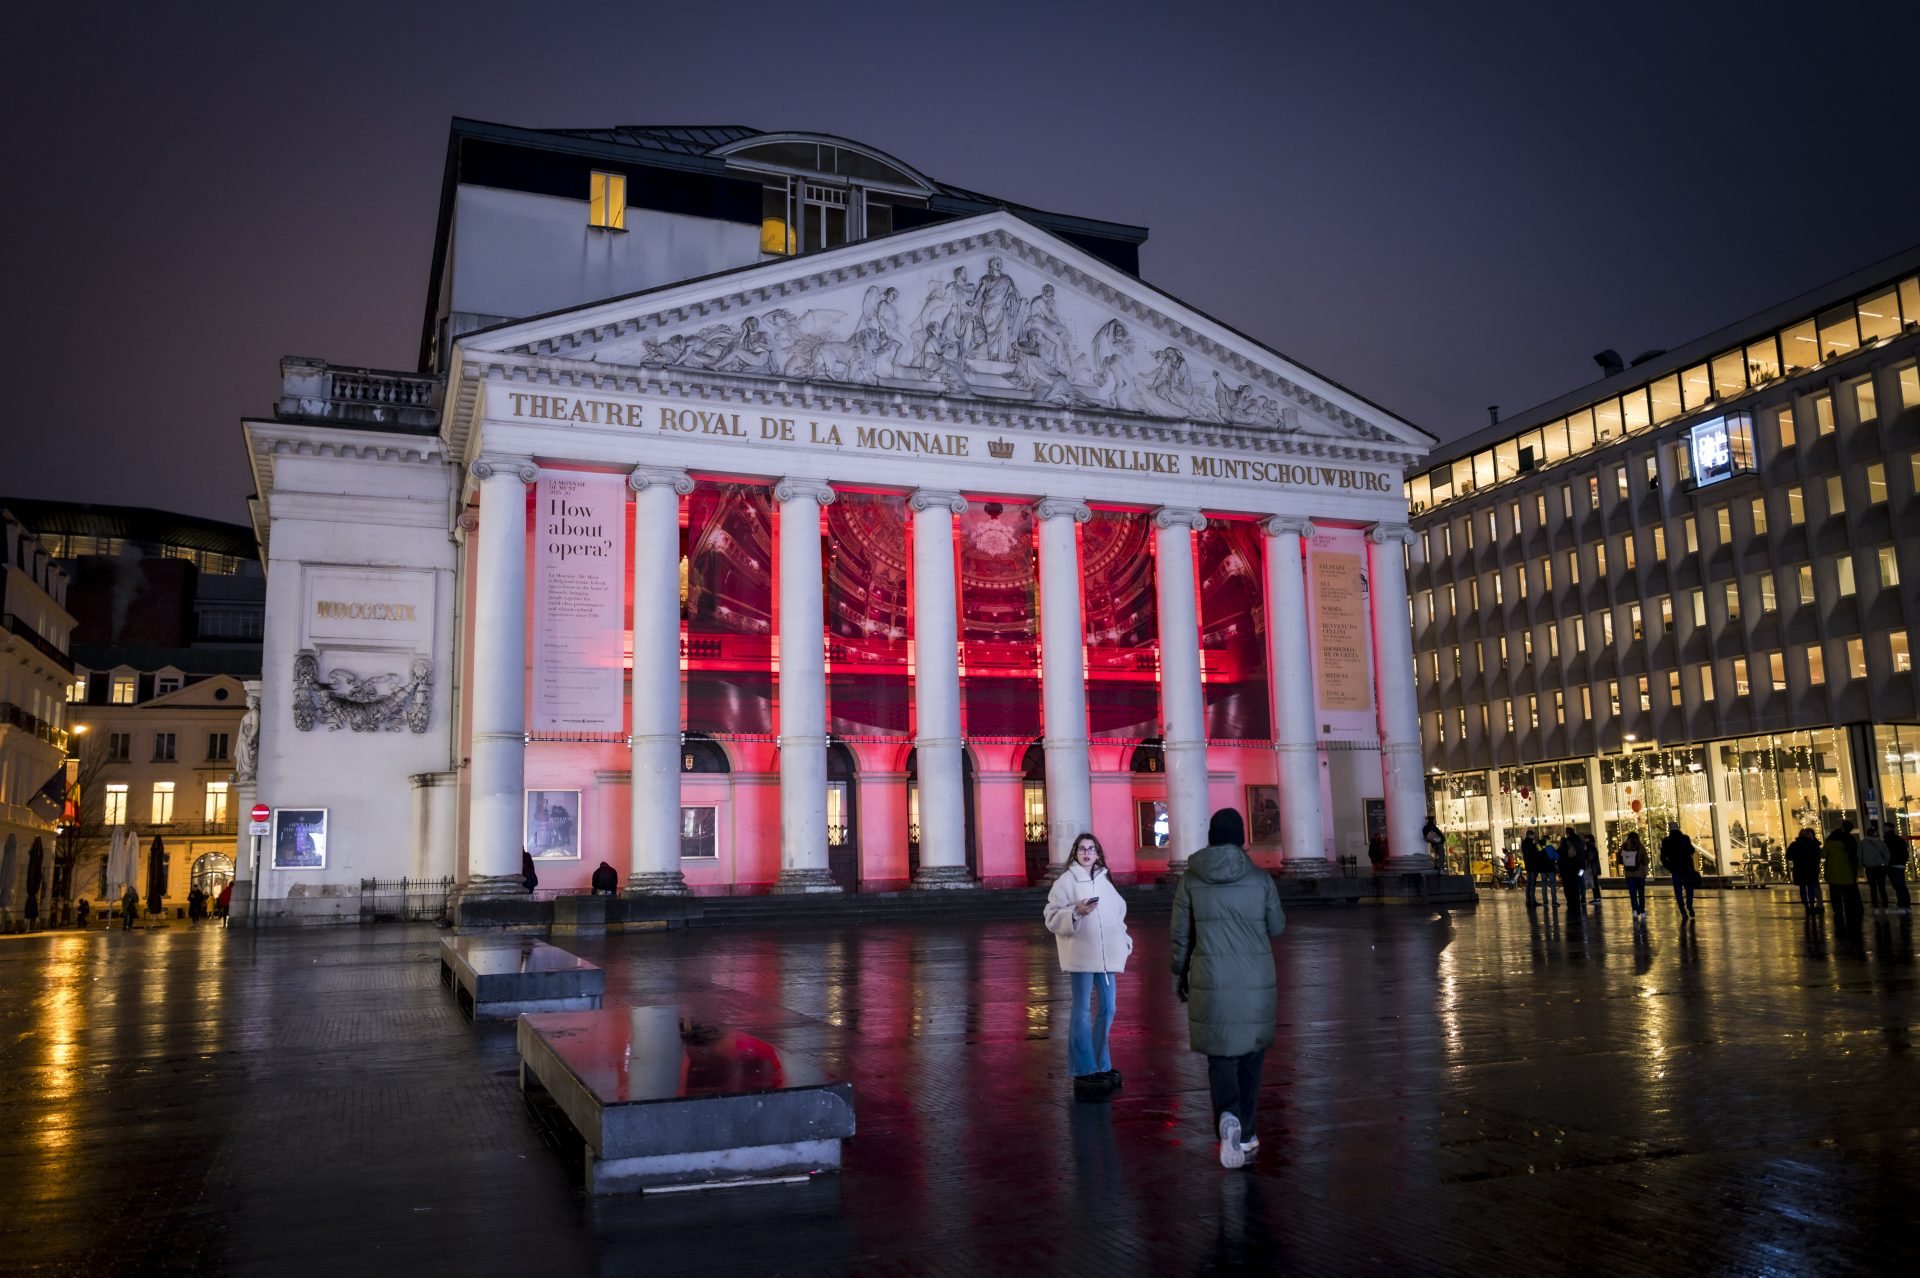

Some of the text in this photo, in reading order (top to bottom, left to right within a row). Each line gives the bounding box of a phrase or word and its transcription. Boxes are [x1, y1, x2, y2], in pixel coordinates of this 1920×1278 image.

[509, 392, 969, 457] THEATRE ROYAL DE LA MONNAIE
[1033, 442, 1391, 492] KONINKLIJKE MUNTSCHOUWBURG
[550, 499, 594, 518] How
[548, 518, 604, 538] about
[548, 540, 612, 561] opera?
